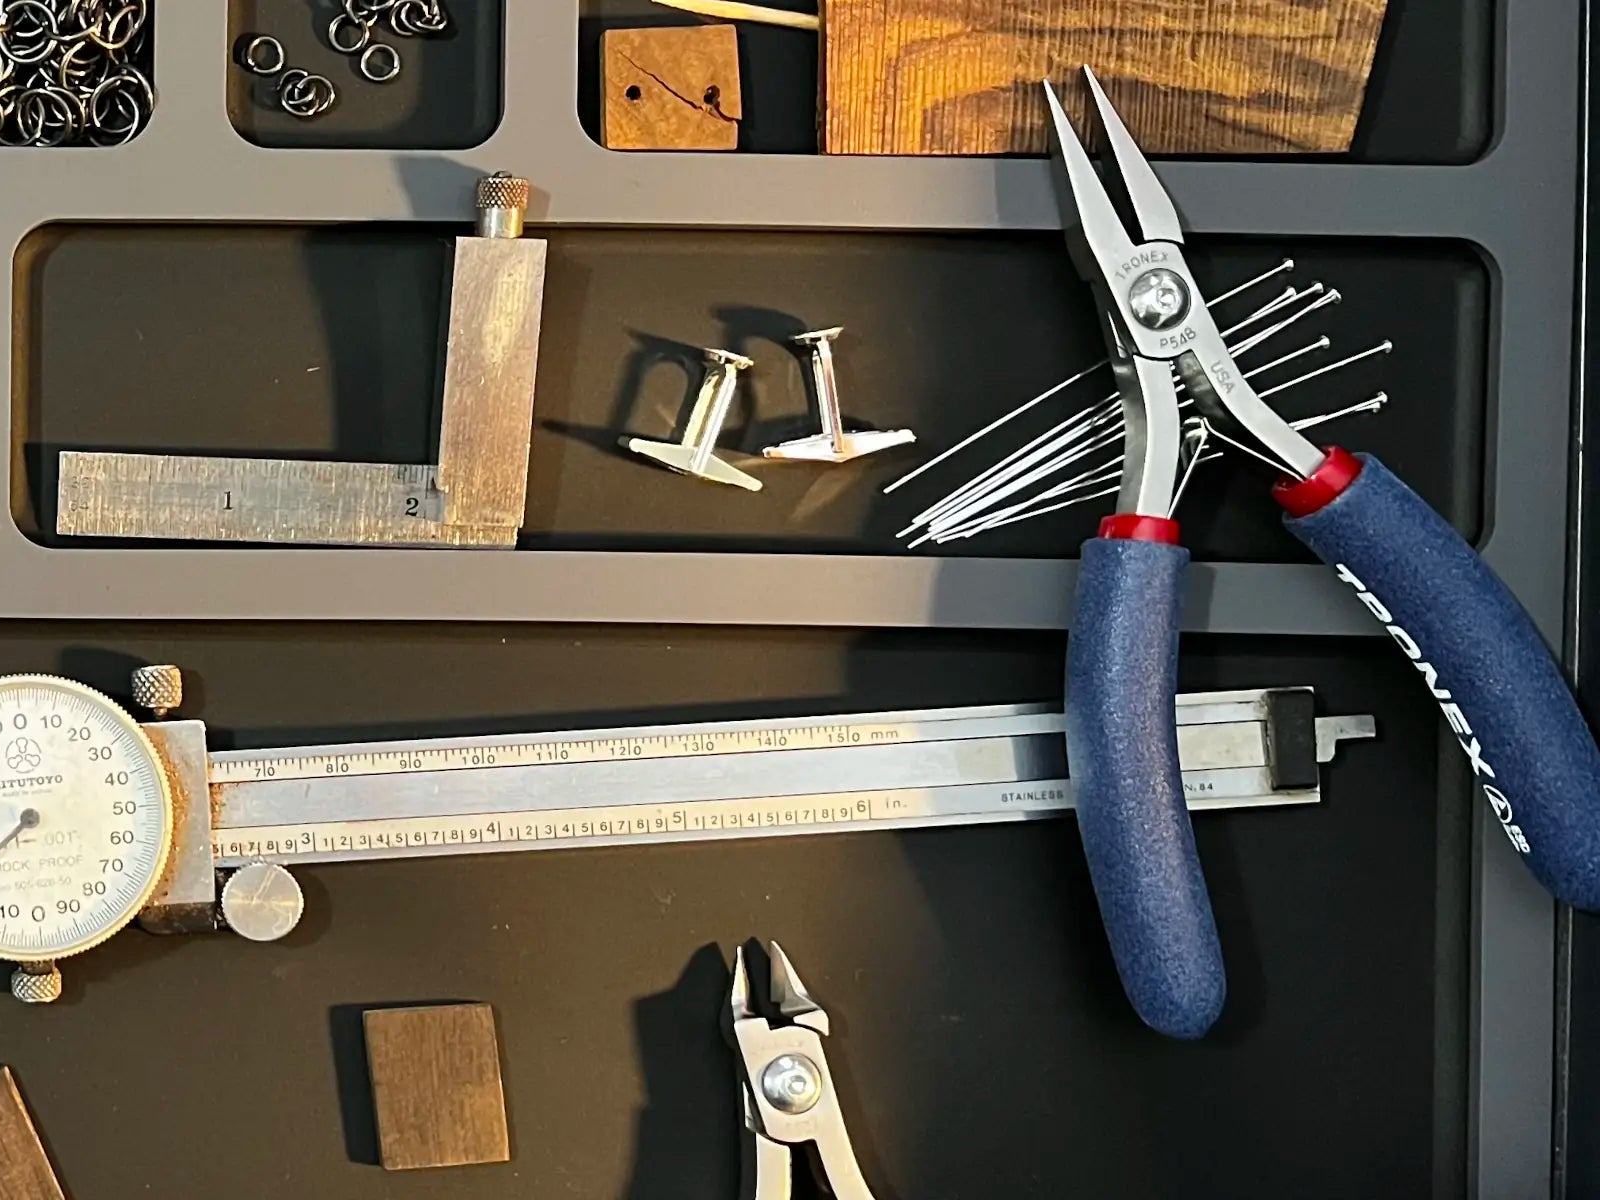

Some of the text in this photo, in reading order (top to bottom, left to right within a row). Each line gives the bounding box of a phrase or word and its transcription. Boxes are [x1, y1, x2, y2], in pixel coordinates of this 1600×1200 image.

[1115, 250, 1169, 281] TRONEX
[1210, 360, 1236, 394] USA
[223, 490, 419, 517] 1 2
[13, 713, 27, 730] 0
[39, 714, 62, 729] 10
[67, 727, 91, 742] 20
[88, 746, 112, 761] 30
[105, 771, 129, 786] 40
[1001, 790, 1064, 803] STAINLESS
[113, 801, 137, 815] 50
[212, 844, 219, 854] 5
[230, 842, 238, 852] 6
[248, 842, 255, 851] 7
[267, 841, 274, 850] 8
[285, 839, 293, 849] 9
[301, 832, 310, 844] 3
[340, 836, 347, 846] 2
[359, 835, 367, 845] 3
[376, 834, 384, 843] 4
[396, 833, 403, 843] 5
[414, 832, 422, 842] 6
[432, 831, 439, 841] 7
[451, 830, 459, 840] 8
[469, 829, 477, 838] 9
[486, 822, 496, 834] 4
[526, 825, 532, 835] 2
[545, 824, 552, 834] 3
[562, 823, 570, 833] 4
[581, 822, 589, 832] 5
[600, 821, 607, 831] 6
[618, 820, 625, 830] 7
[637, 819, 644, 829] 8
[655, 818, 663, 828] 9
[673, 812, 682, 824] 5
[711, 815, 718, 825] 2
[731, 814, 738, 824] 3
[747, 812, 755, 822] 4
[767, 811, 774, 822] 5
[785, 810, 792, 820] 6
[803, 809, 810, 819] 7
[821, 808, 829, 818] 8
[840, 807, 848, 817] 9
[857, 800, 866, 813] 6
[885, 798, 908, 810] in.
[110, 830, 134, 845] 60
[39, 854, 83, 868] PROOF
[99, 858, 123, 874] 70
[82, 881, 106, 896] 80
[31, 905, 46, 922] 0
[56, 899, 80, 914] 90
